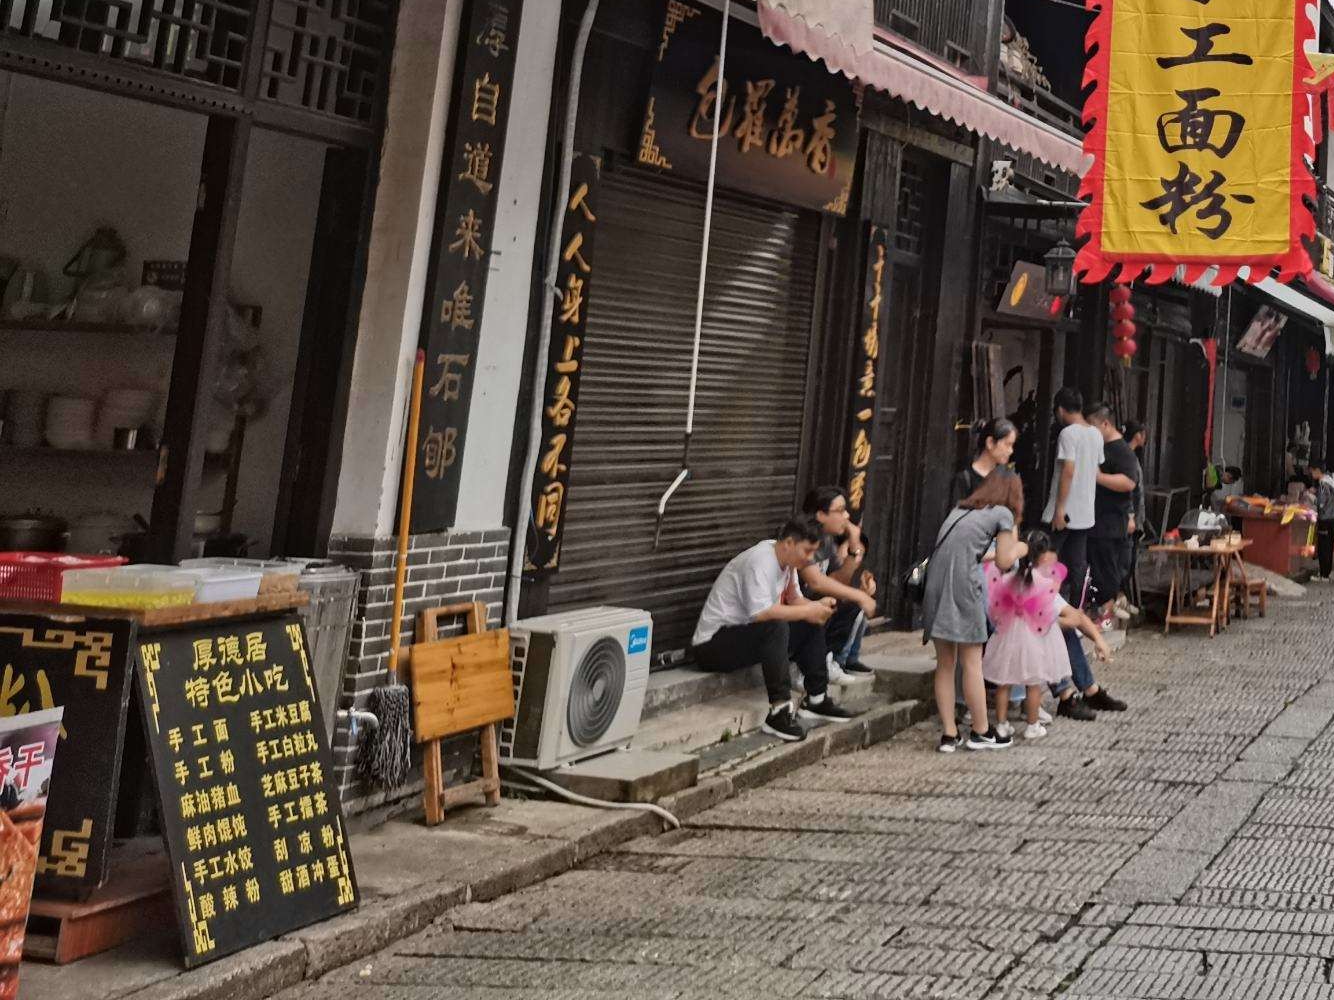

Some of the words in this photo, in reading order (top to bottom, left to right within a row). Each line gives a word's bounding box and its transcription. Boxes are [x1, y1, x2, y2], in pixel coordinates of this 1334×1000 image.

[192, 632, 267, 672] 厚德居
[184, 663, 289, 708] 特色小吃
[168, 717, 229, 752] 手工面
[250, 700, 312, 735] 手工米豆腐
[255, 730, 319, 765] 手工白粒丸
[174, 749, 235, 786] 手工粉
[261, 760, 324, 798] 芝麻豆子茶
[180, 781, 242, 819] 麻油猪血
[187, 812, 248, 851] 鲜肉馄饨
[193, 845, 254, 886] 手工水饺
[279, 854, 340, 895] 甜酒冲蛋
[199, 876, 261, 920] 酸辣粉
